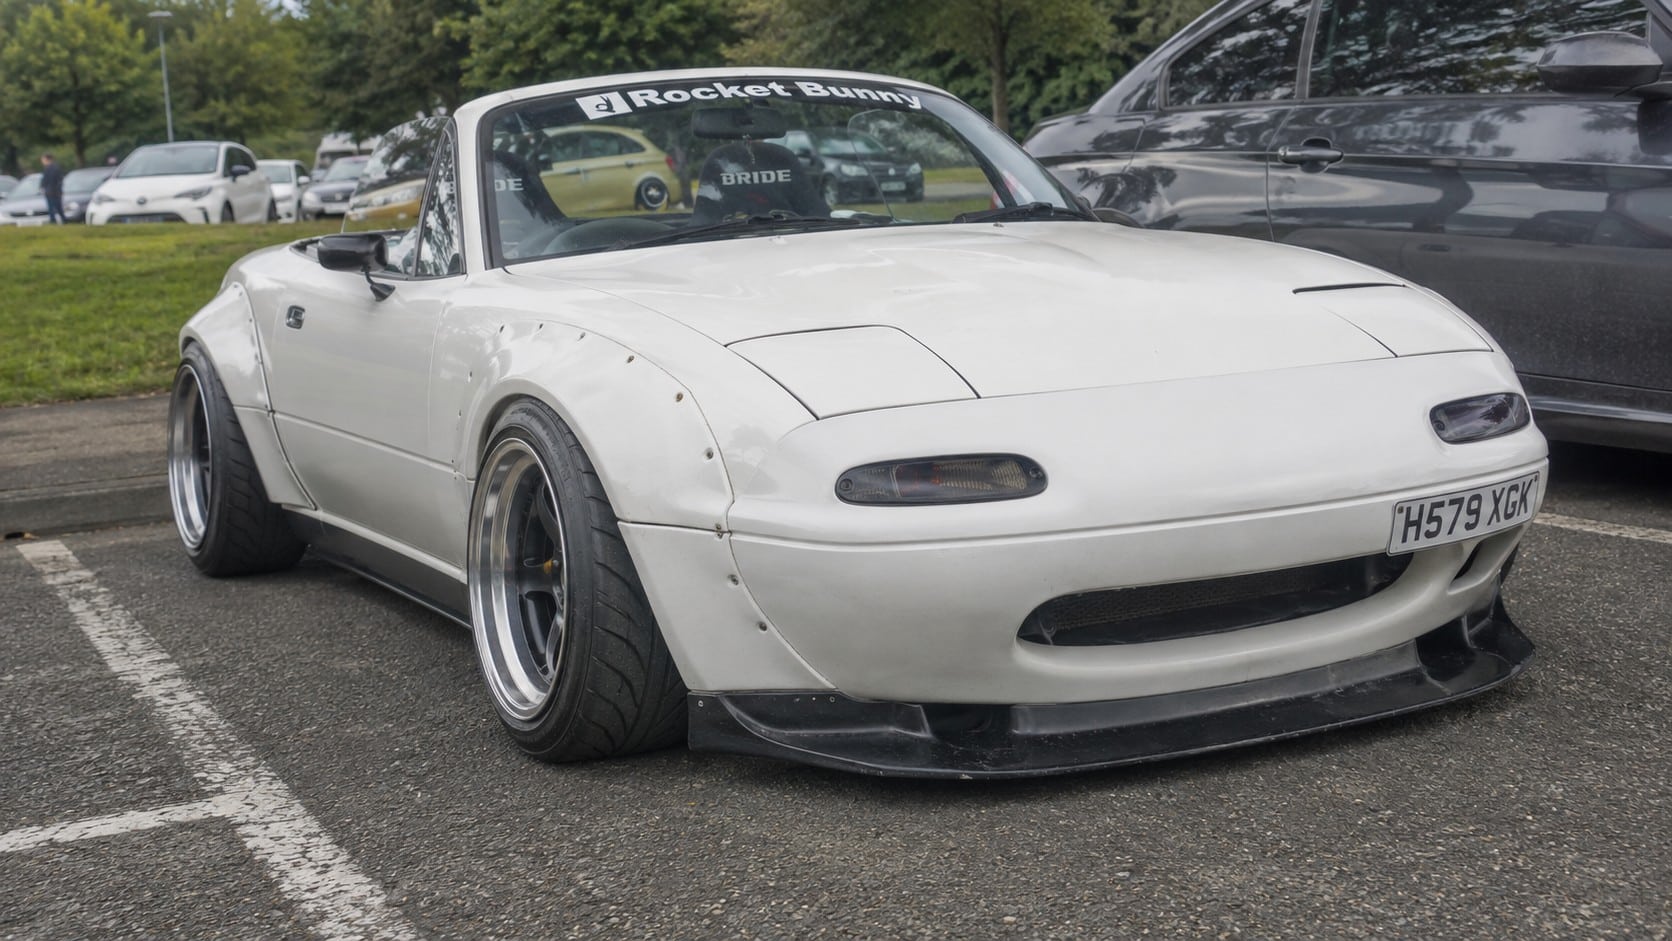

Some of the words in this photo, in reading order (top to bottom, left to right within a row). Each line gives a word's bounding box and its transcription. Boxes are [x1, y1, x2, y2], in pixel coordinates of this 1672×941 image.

[627, 81, 792, 108] Rocket
[794, 81, 922, 110] Bunny
[720, 169, 792, 185] BRIDE
[1401, 493, 1483, 544] H579
[1487, 478, 1534, 526] XGK
